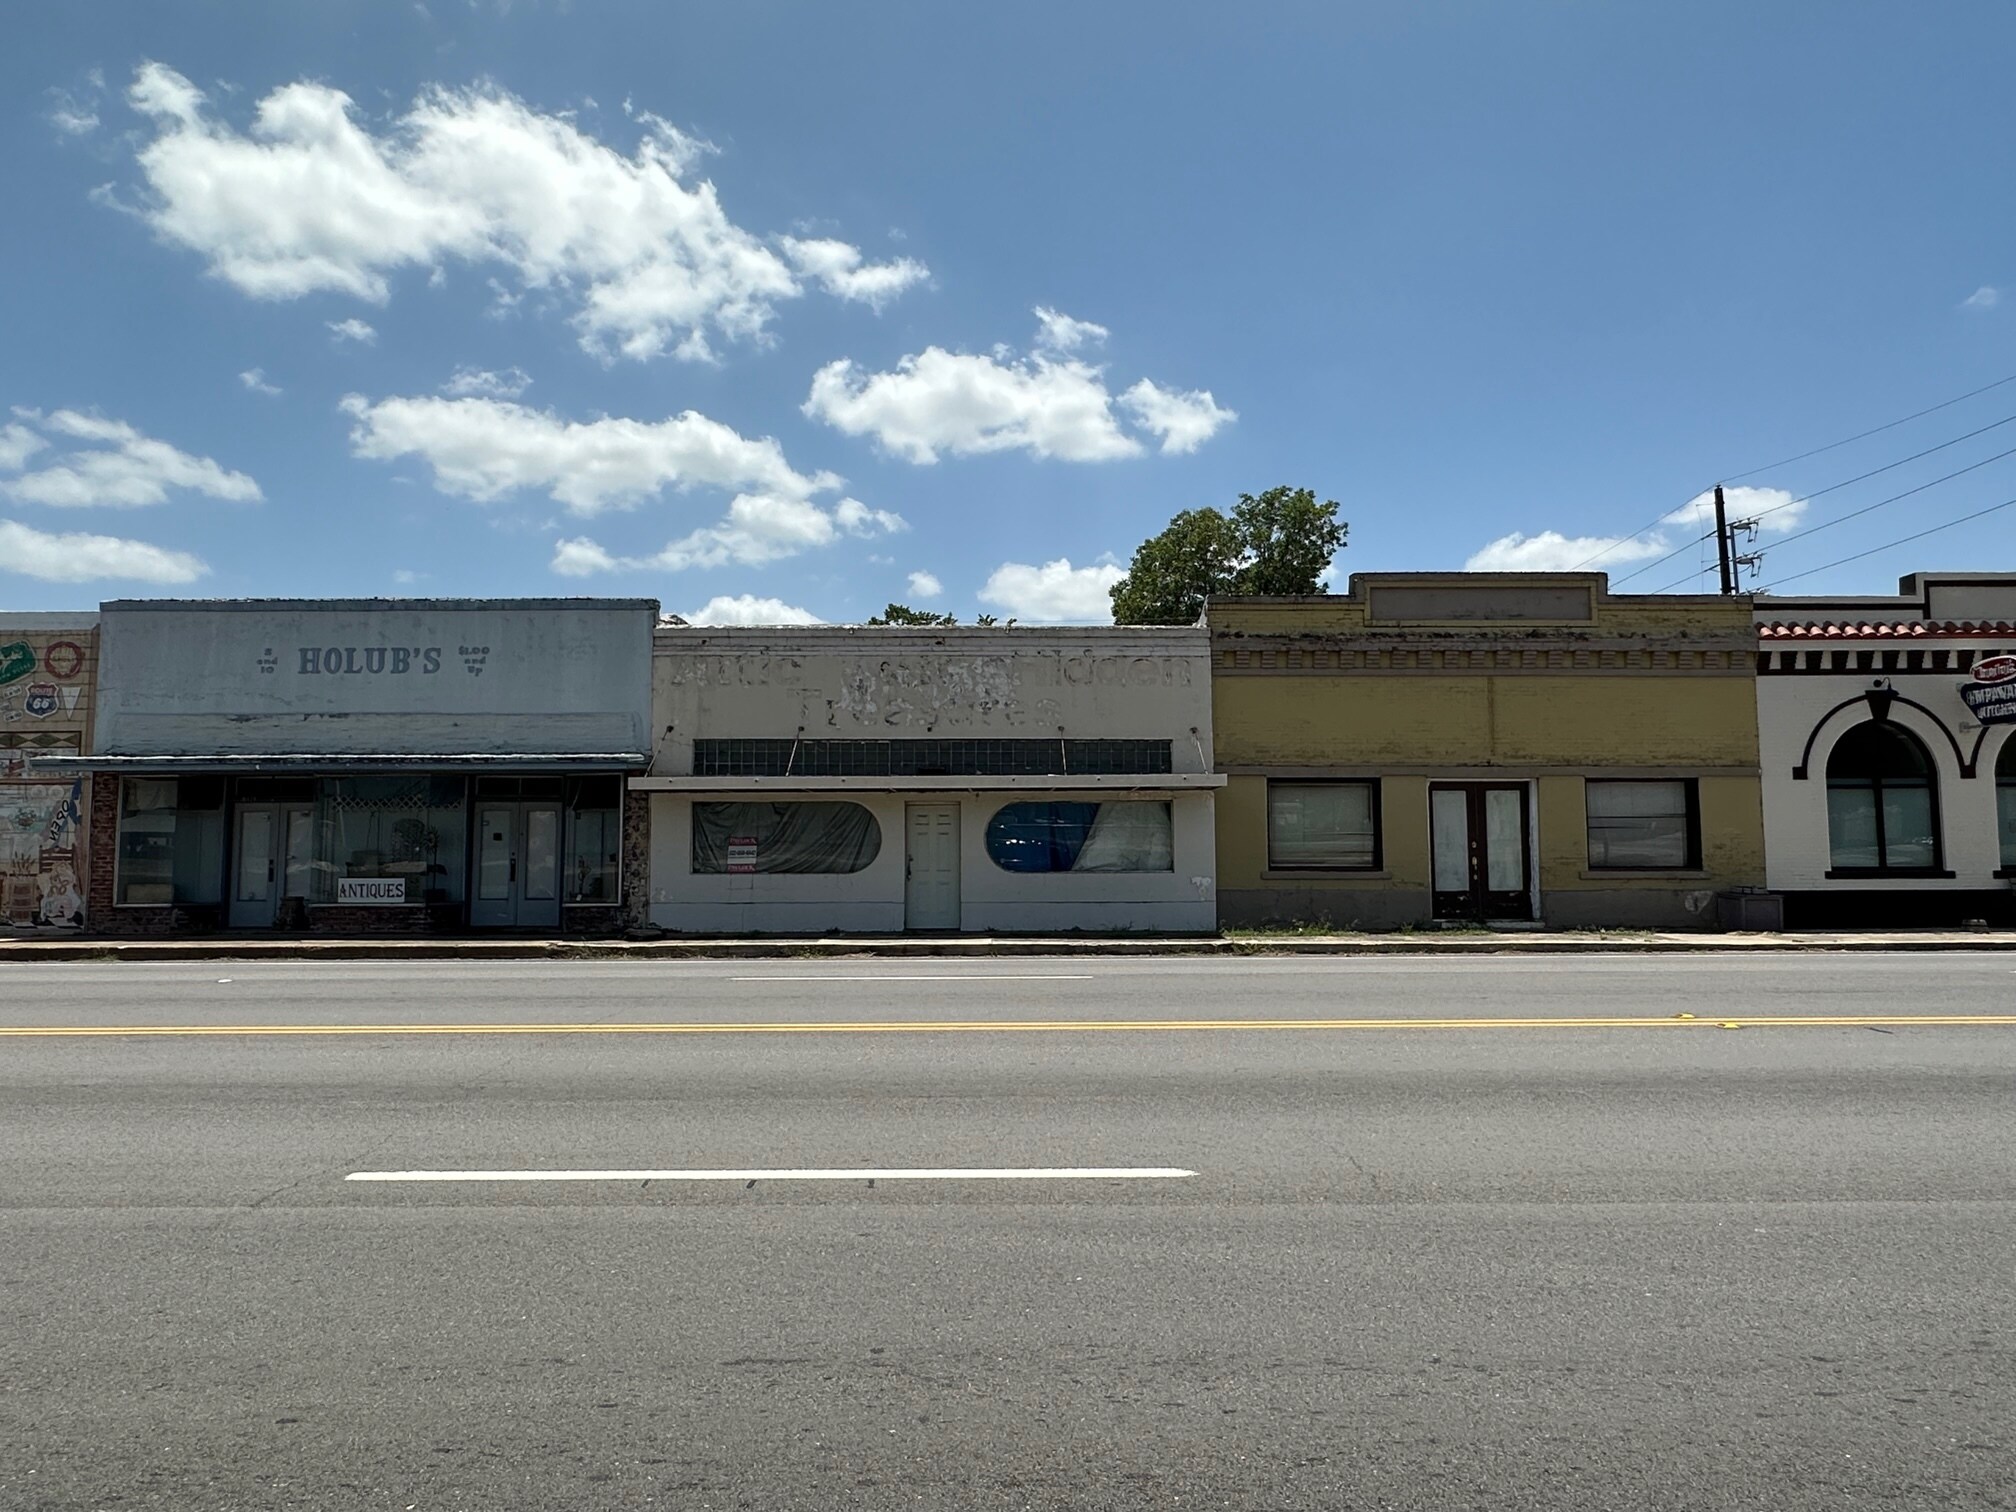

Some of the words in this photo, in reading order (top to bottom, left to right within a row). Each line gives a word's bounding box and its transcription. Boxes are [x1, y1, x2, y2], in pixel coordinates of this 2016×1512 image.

[458, 646, 490, 655] $1.00
[256, 656, 278, 665] and
[298, 647, 442, 674] HOLUB'S
[464, 656, 486, 665] and
[260, 666, 274, 674] 10
[30, 686, 54, 695] ROUTE
[32, 697, 50, 710] 66
[339, 883, 404, 899] ANTIQUES
